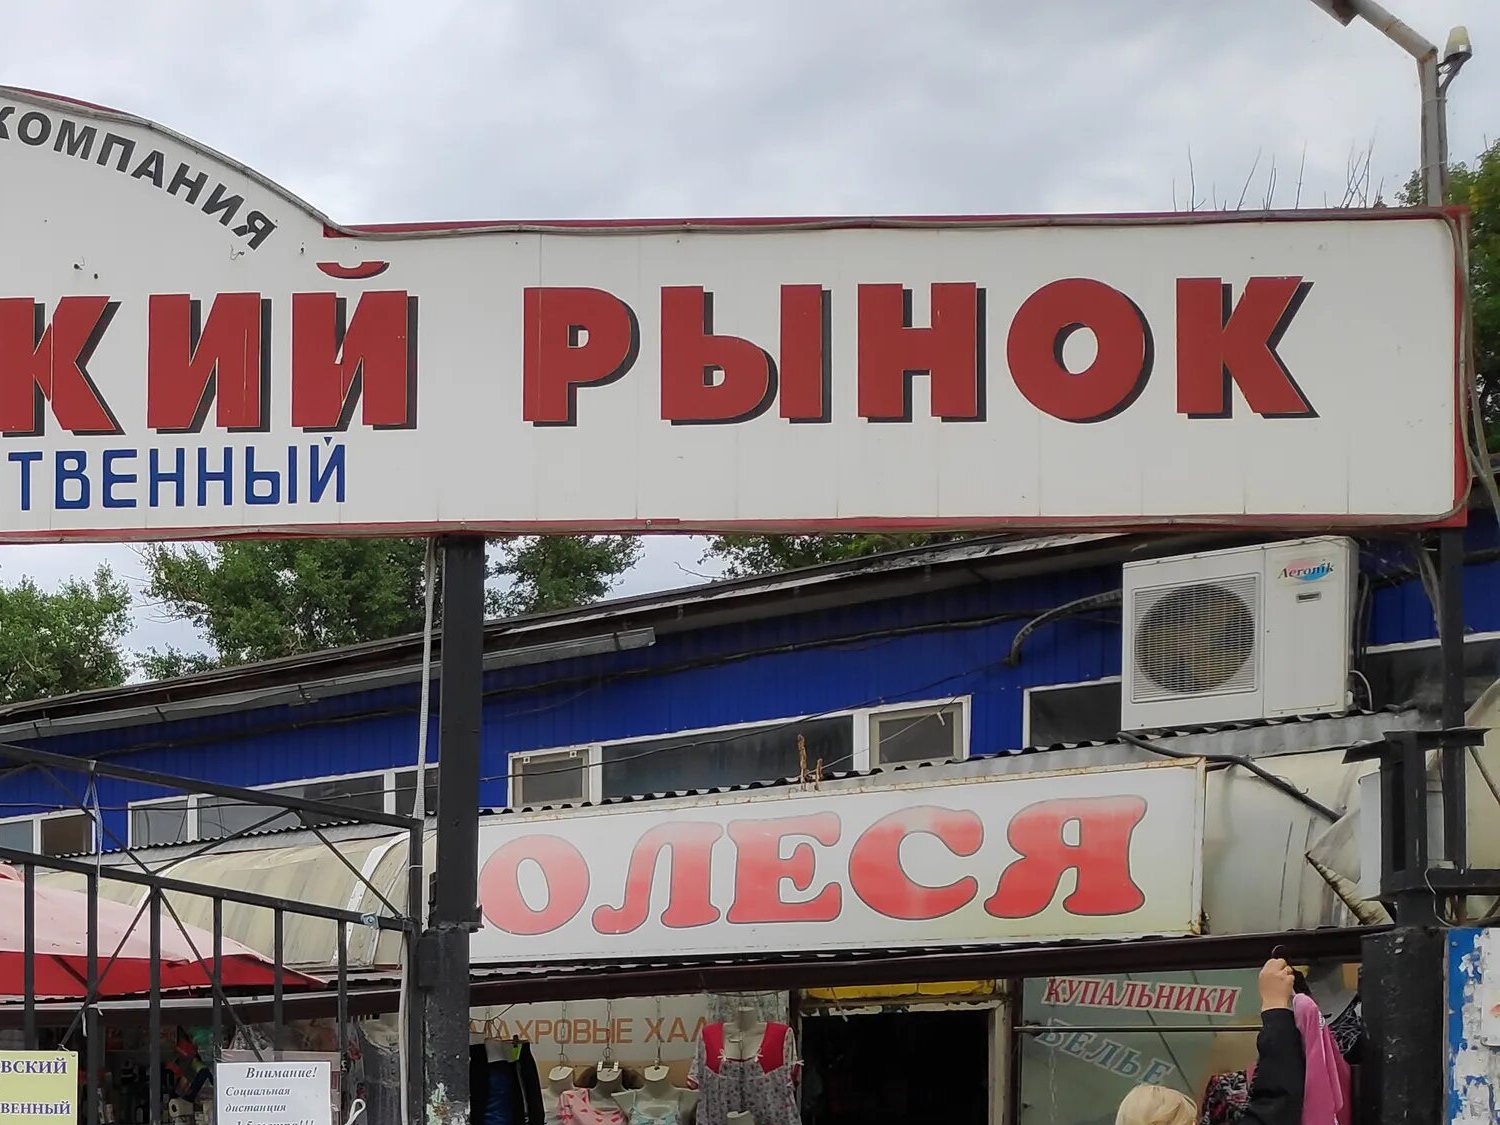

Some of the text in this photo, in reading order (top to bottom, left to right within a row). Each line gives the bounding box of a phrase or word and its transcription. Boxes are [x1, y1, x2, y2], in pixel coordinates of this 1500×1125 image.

[522, 275, 1320, 427] РЫНОК
[478, 795, 1148, 936] ОЛЕСЯ
[1043, 978, 1238, 1015] КУПАЛЬНИКИ
[245, 1066, 318, 1079] Внимание!
[225, 1086, 291, 1098] Социальная
[225, 1103, 287, 1114] дистанция
